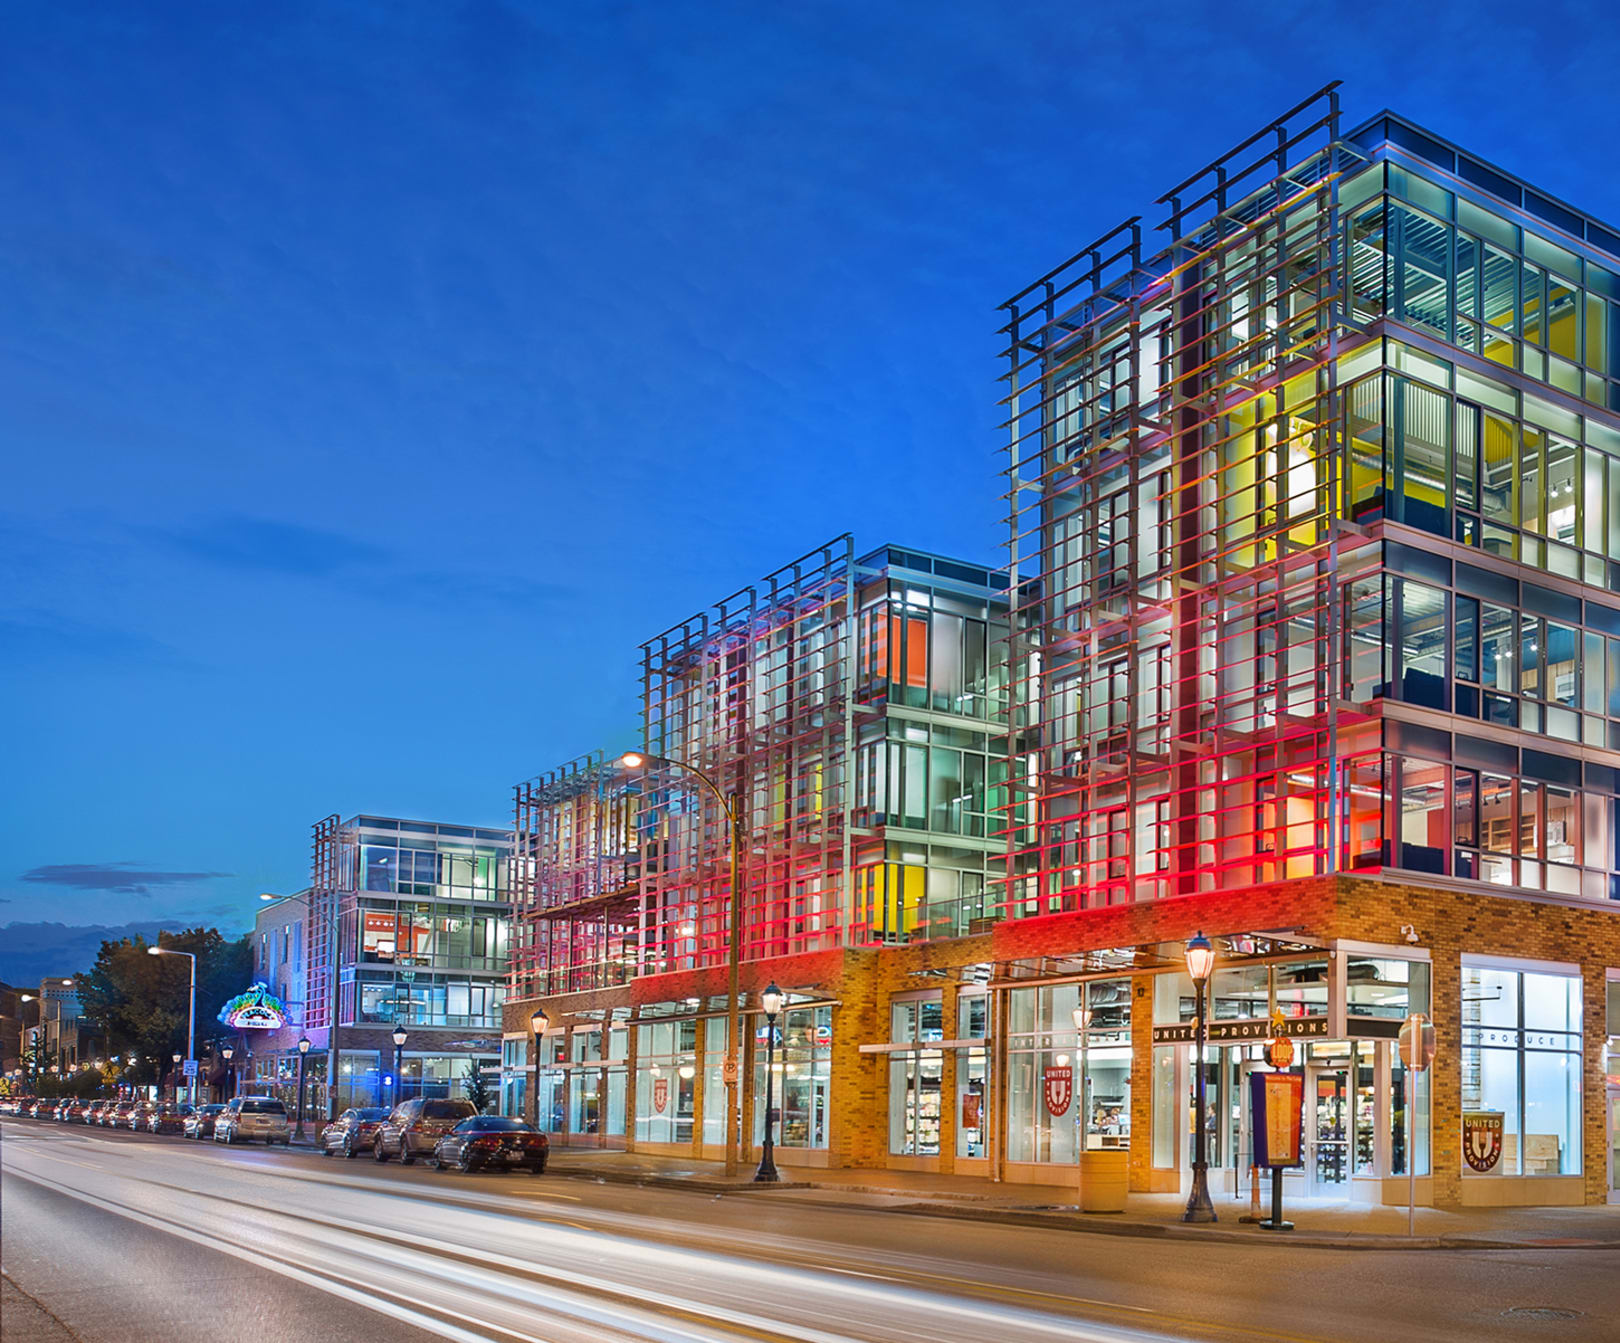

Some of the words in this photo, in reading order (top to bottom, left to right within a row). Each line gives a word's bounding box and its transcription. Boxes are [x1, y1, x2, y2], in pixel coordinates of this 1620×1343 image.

[1154, 1029, 1208, 1040] UNITED
[1478, 1033, 1555, 1046] PRODUCE
[1272, 1044, 1293, 1059] LOOP
[1046, 1070, 1071, 1078] UNITED
[1465, 1119, 1500, 1129] UNITED
